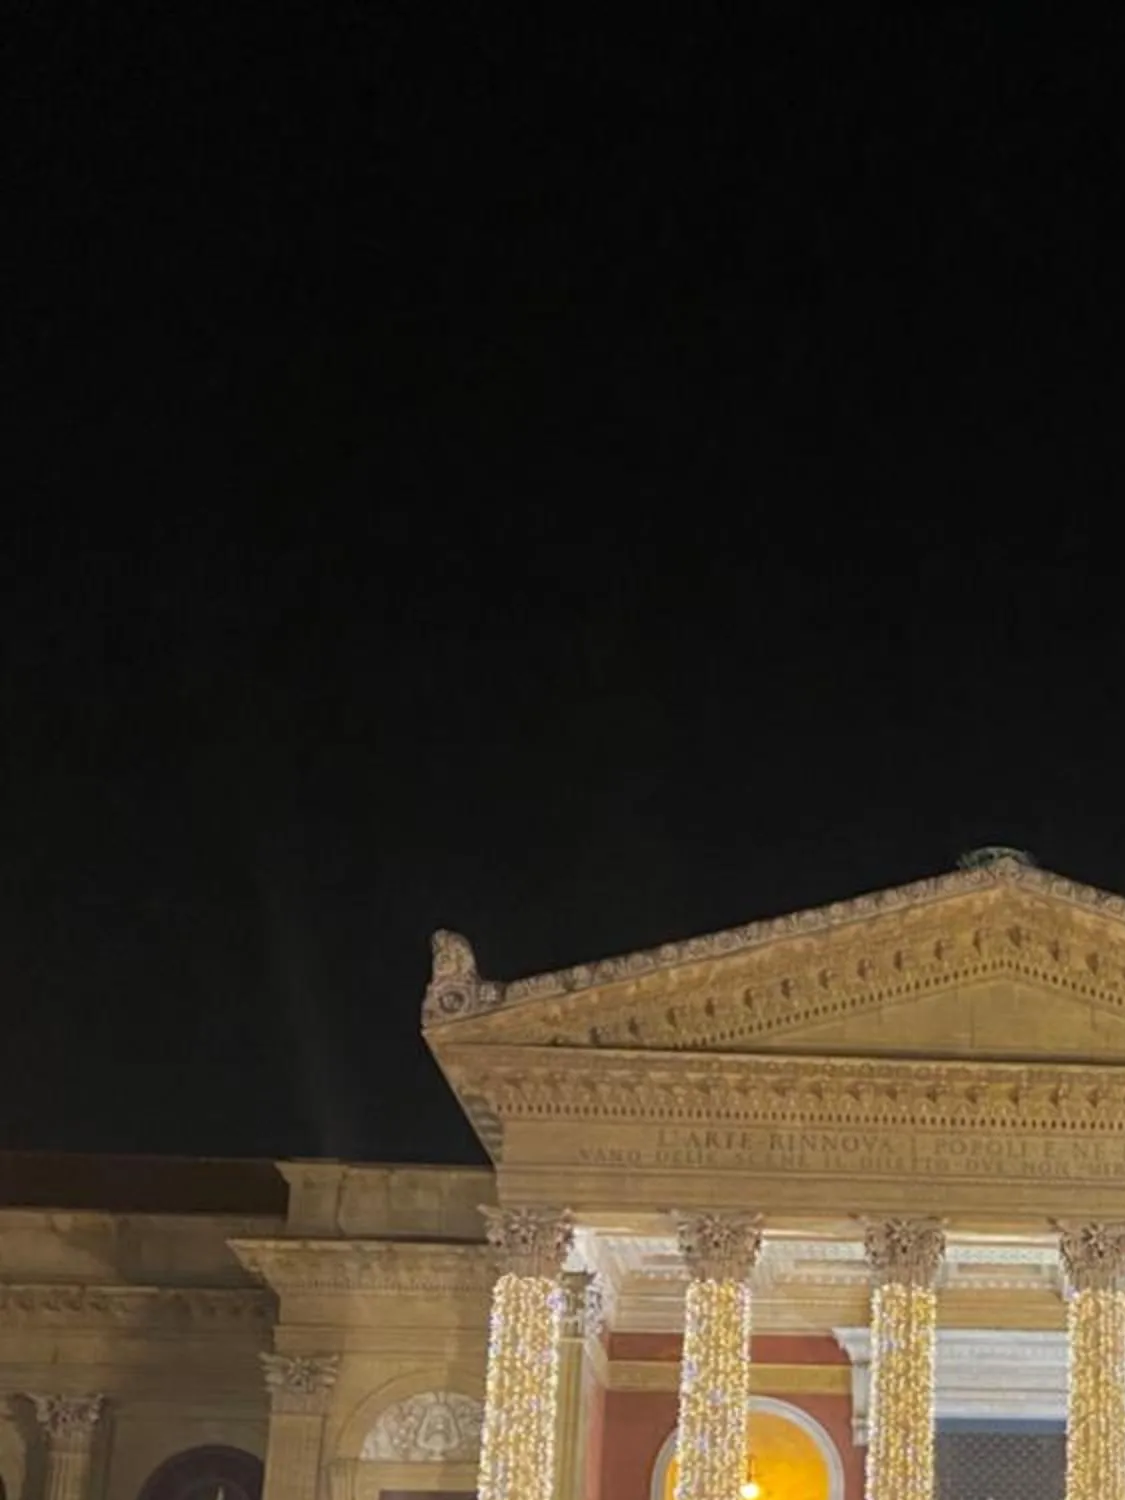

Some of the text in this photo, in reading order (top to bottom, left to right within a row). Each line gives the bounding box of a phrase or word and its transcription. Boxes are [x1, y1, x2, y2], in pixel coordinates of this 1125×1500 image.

[656, 1129, 753, 1150] L'ARTE
[769, 1132, 896, 1154] RINNOVA
[932, 1137, 1026, 1158] POPOLI
[1043, 1140, 1057, 1159] E
[1072, 1141, 1104, 1160] NE
